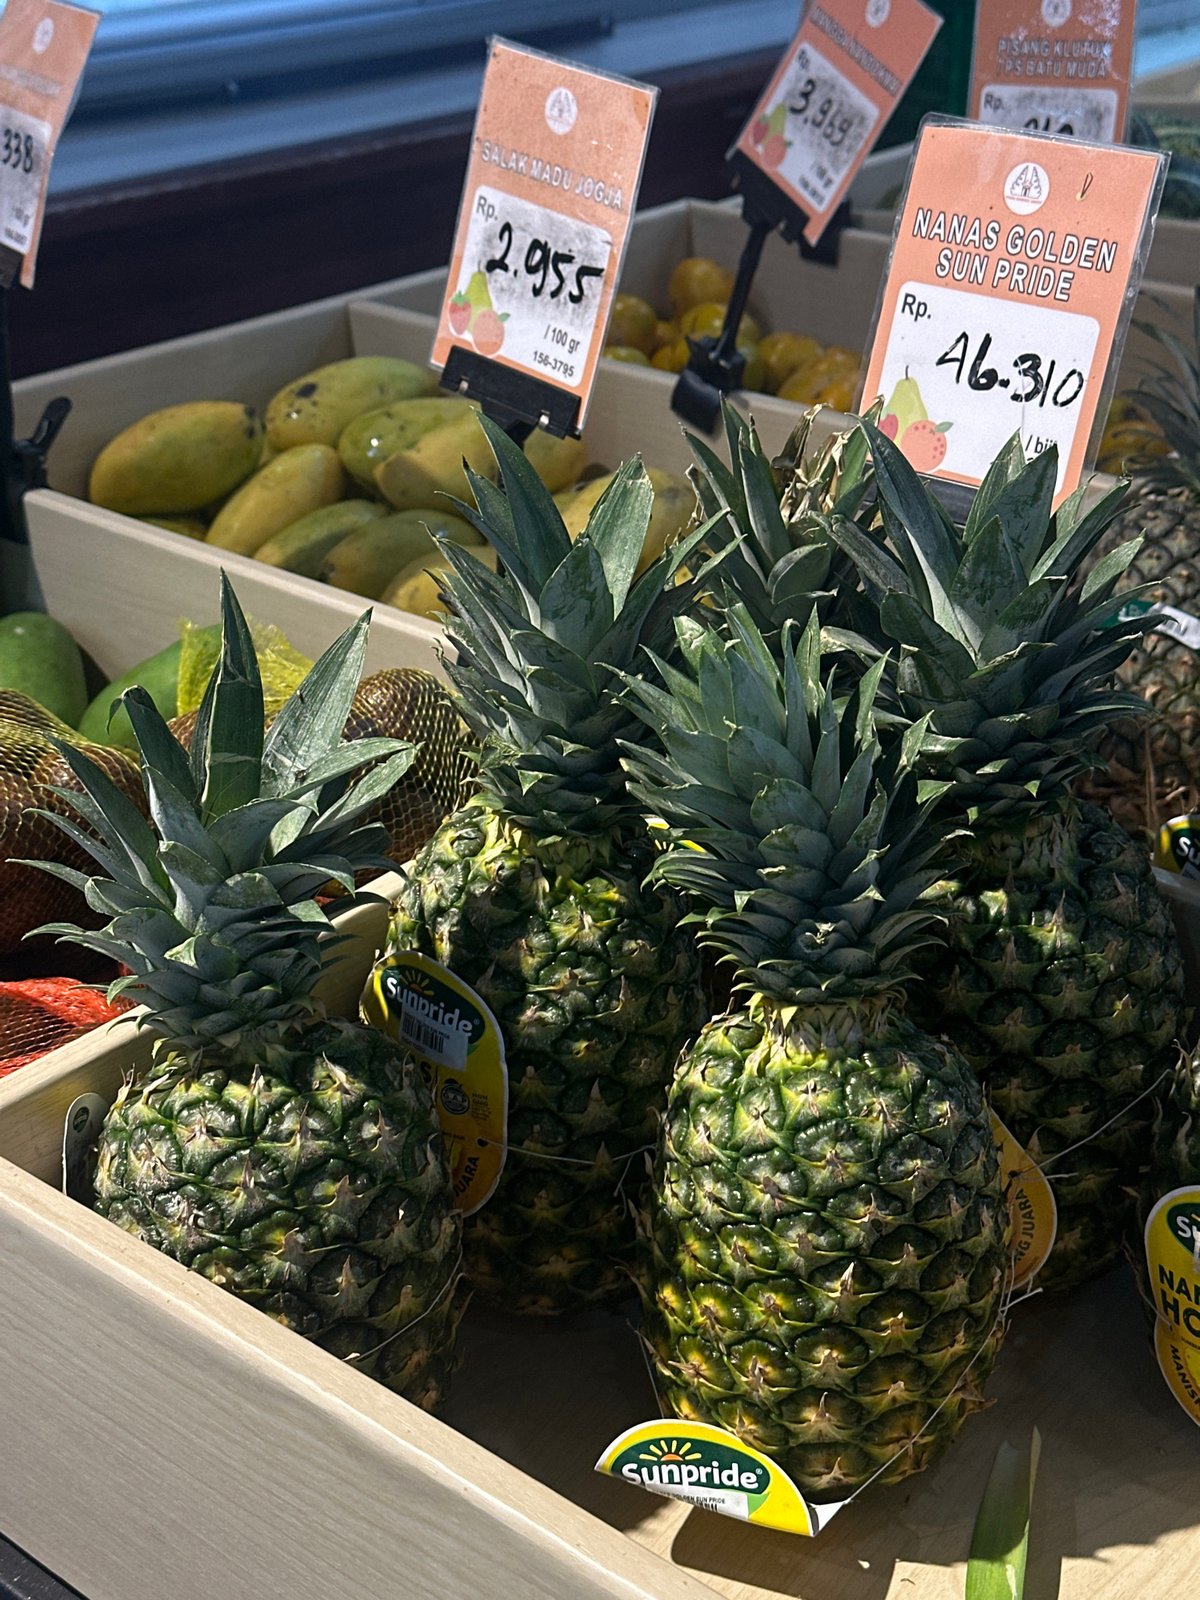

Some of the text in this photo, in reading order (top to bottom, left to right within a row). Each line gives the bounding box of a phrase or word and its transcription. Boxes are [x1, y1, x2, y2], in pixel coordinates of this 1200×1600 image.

[481, 141, 623, 209] SALAK MADU JOGJA
[476, 195, 498, 222] Rp.
[485, 221, 605, 304] 2.955
[912, 207, 1119, 273] NANAS GOLDEN
[935, 247, 1076, 302] SUN PRIDE
[901, 292, 932, 322] Rp.
[533, 350, 575, 378] 156-3795
[567, 338, 581, 354] gr
[936, 331, 1084, 408] 46.310
[386, 976, 473, 1037] Sunpride
[1015, 1188, 1035, 1239] JUARA
[621, 1460, 759, 1489] Sunpride
